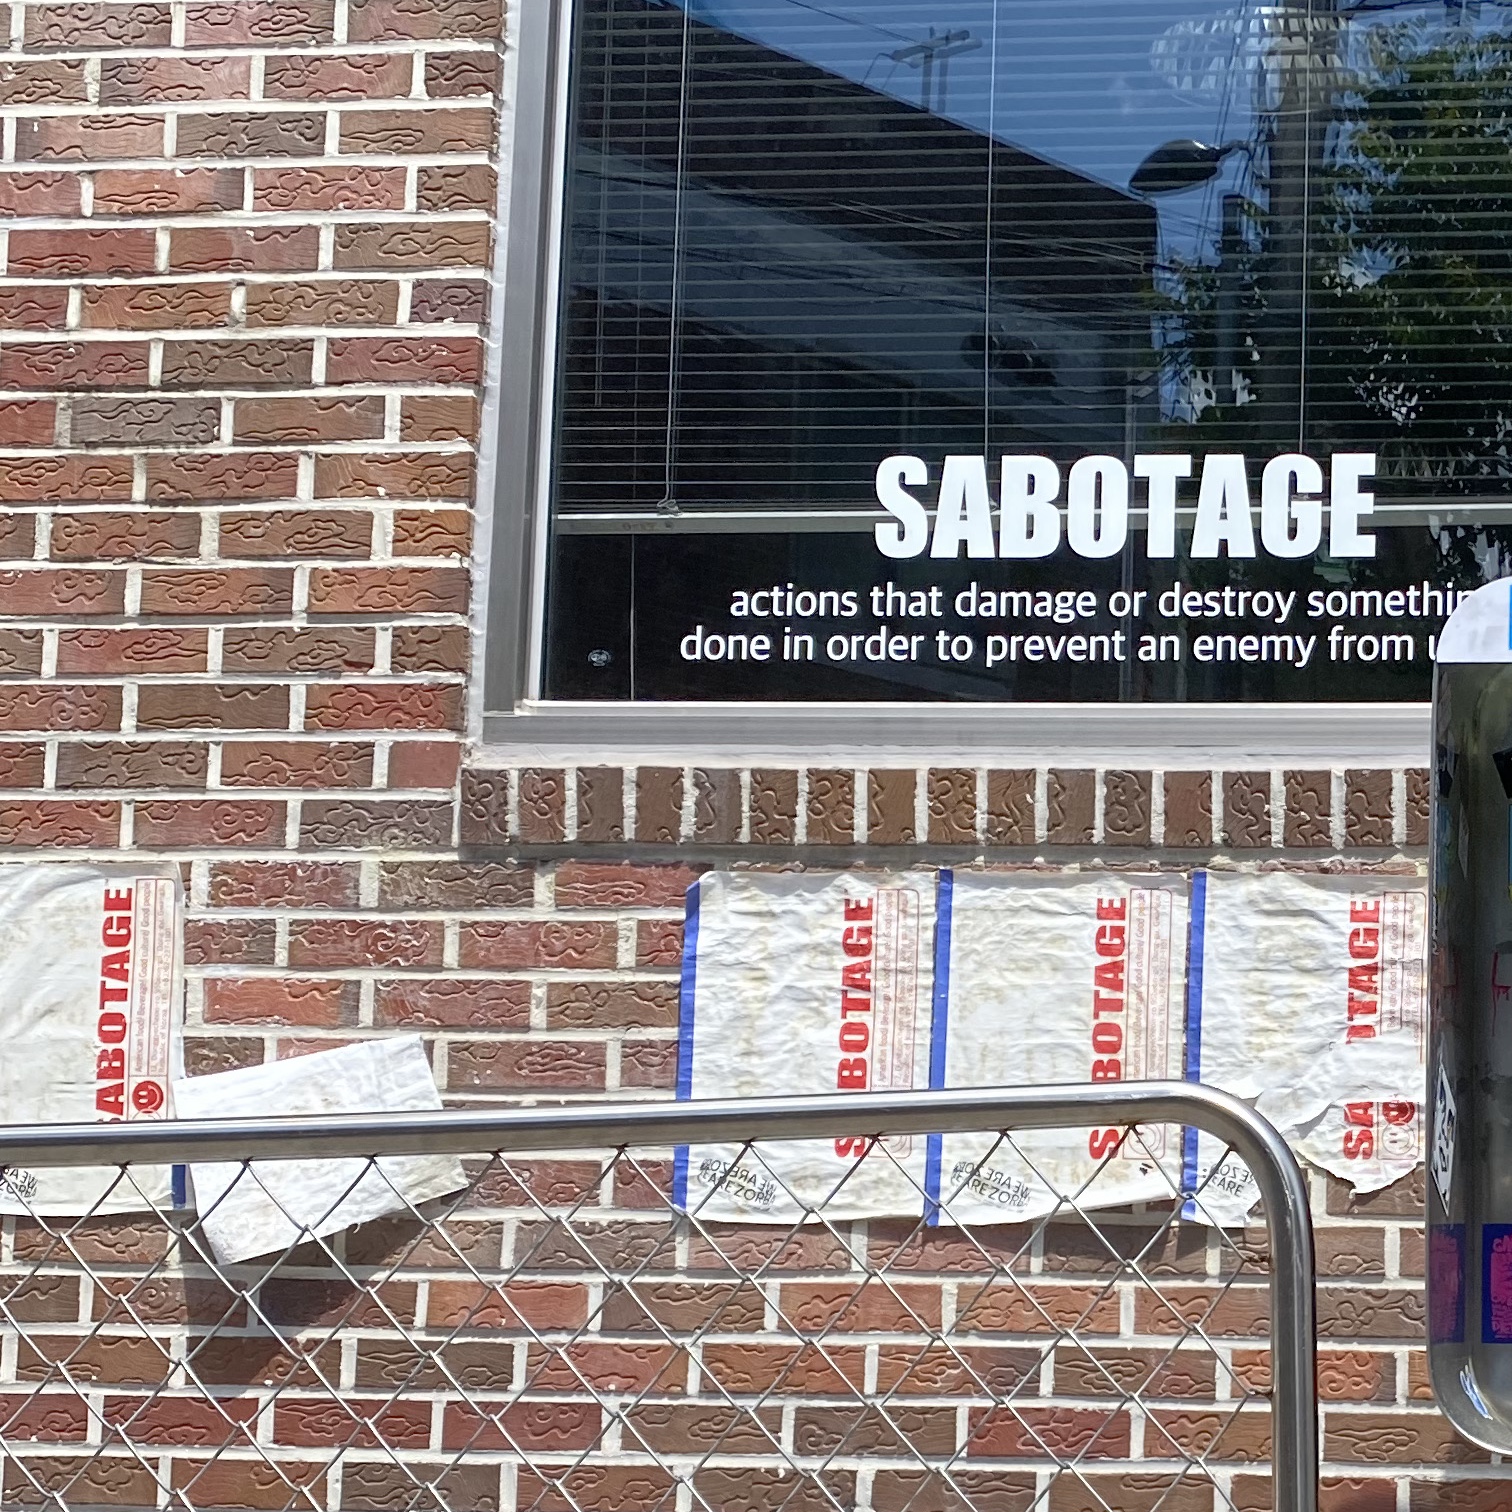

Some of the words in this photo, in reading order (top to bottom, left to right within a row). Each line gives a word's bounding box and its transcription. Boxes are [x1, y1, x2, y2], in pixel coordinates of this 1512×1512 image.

[874, 453, 1377, 559] SABOTAGE
[681, 625, 770, 661] done
[784, 627, 813, 661] in
[827, 626, 924, 661] order
[936, 631, 973, 661] to
[987, 630, 1125, 668] prevent
[1138, 636, 1179, 661] an
[1194, 636, 1316, 668] enemy
[1328, 625, 1413, 661] from
[731, 583, 857, 617] actions
[870, 582, 942, 617] that
[955, 582, 1096, 624] damage
[1109, 591, 1146, 617] or
[1159, 582, 1295, 625] destroy
[96, 888, 133, 1122] ABOTAGE
[835, 898, 873, 1157] SBOTAGE
[1089, 897, 1126, 1160] SBOTAGE
